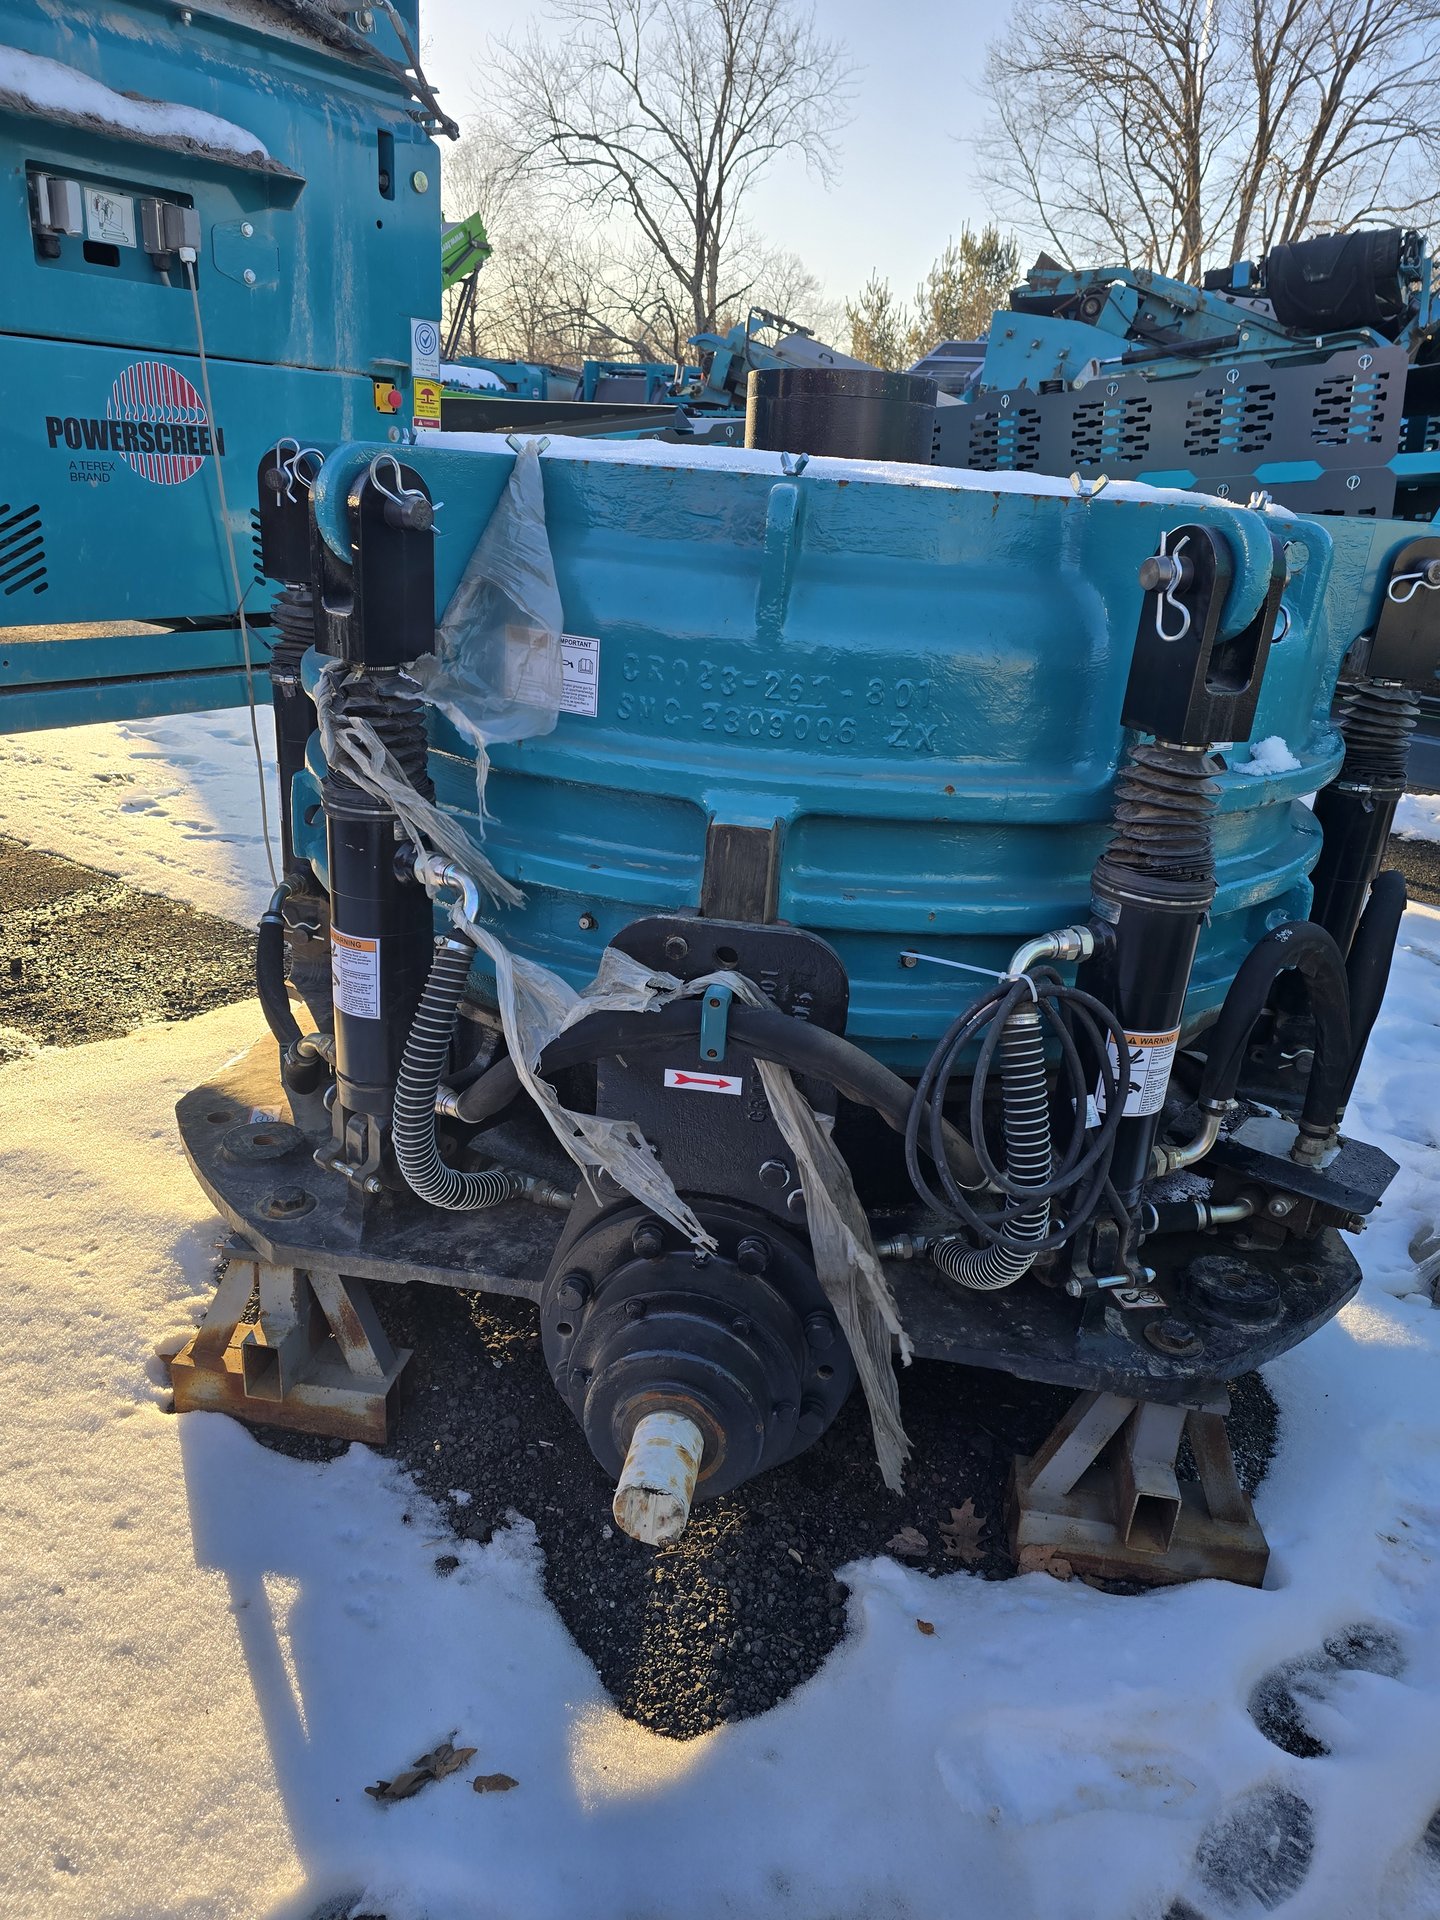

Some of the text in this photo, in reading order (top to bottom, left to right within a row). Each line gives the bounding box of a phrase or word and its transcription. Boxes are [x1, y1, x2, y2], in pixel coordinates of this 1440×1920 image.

[45, 416, 226, 457] POWERSCREEN
[69, 461, 116, 472] A TEREX
[70, 472, 111, 483] BRAND
[560, 637, 592, 648] MPORTANT
[1140, 1035, 1174, 1045] WARNING
